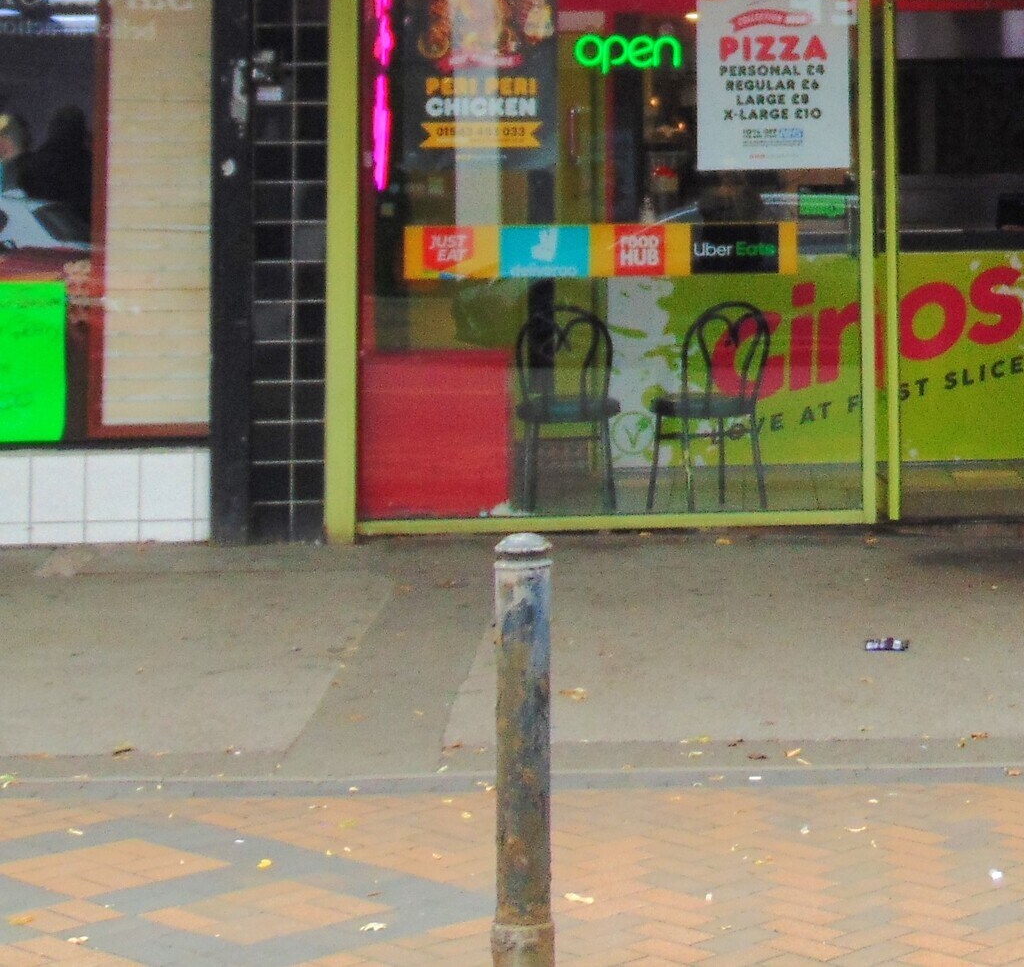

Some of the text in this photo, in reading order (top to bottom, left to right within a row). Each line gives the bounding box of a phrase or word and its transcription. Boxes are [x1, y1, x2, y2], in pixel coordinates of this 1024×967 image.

[574, 33, 683, 75] open
[719, 34, 828, 62] PIZZA
[719, 63, 826, 77] PERSONAL £4
[725, 78, 820, 91] REGULAR £6
[425, 97, 537, 117] CHICKEN
[736, 94, 786, 106] LARGE
[723, 107, 822, 121] X-LARGE £10
[429, 234, 467, 250] JUST
[619, 235, 660, 248] FOOD
[437, 249, 467, 263] EAT
[619, 248, 660, 266] HUB
[693, 242, 733, 257] Uber
[800, 401, 832, 425] AT
[944, 354, 1024, 392] SLICE
